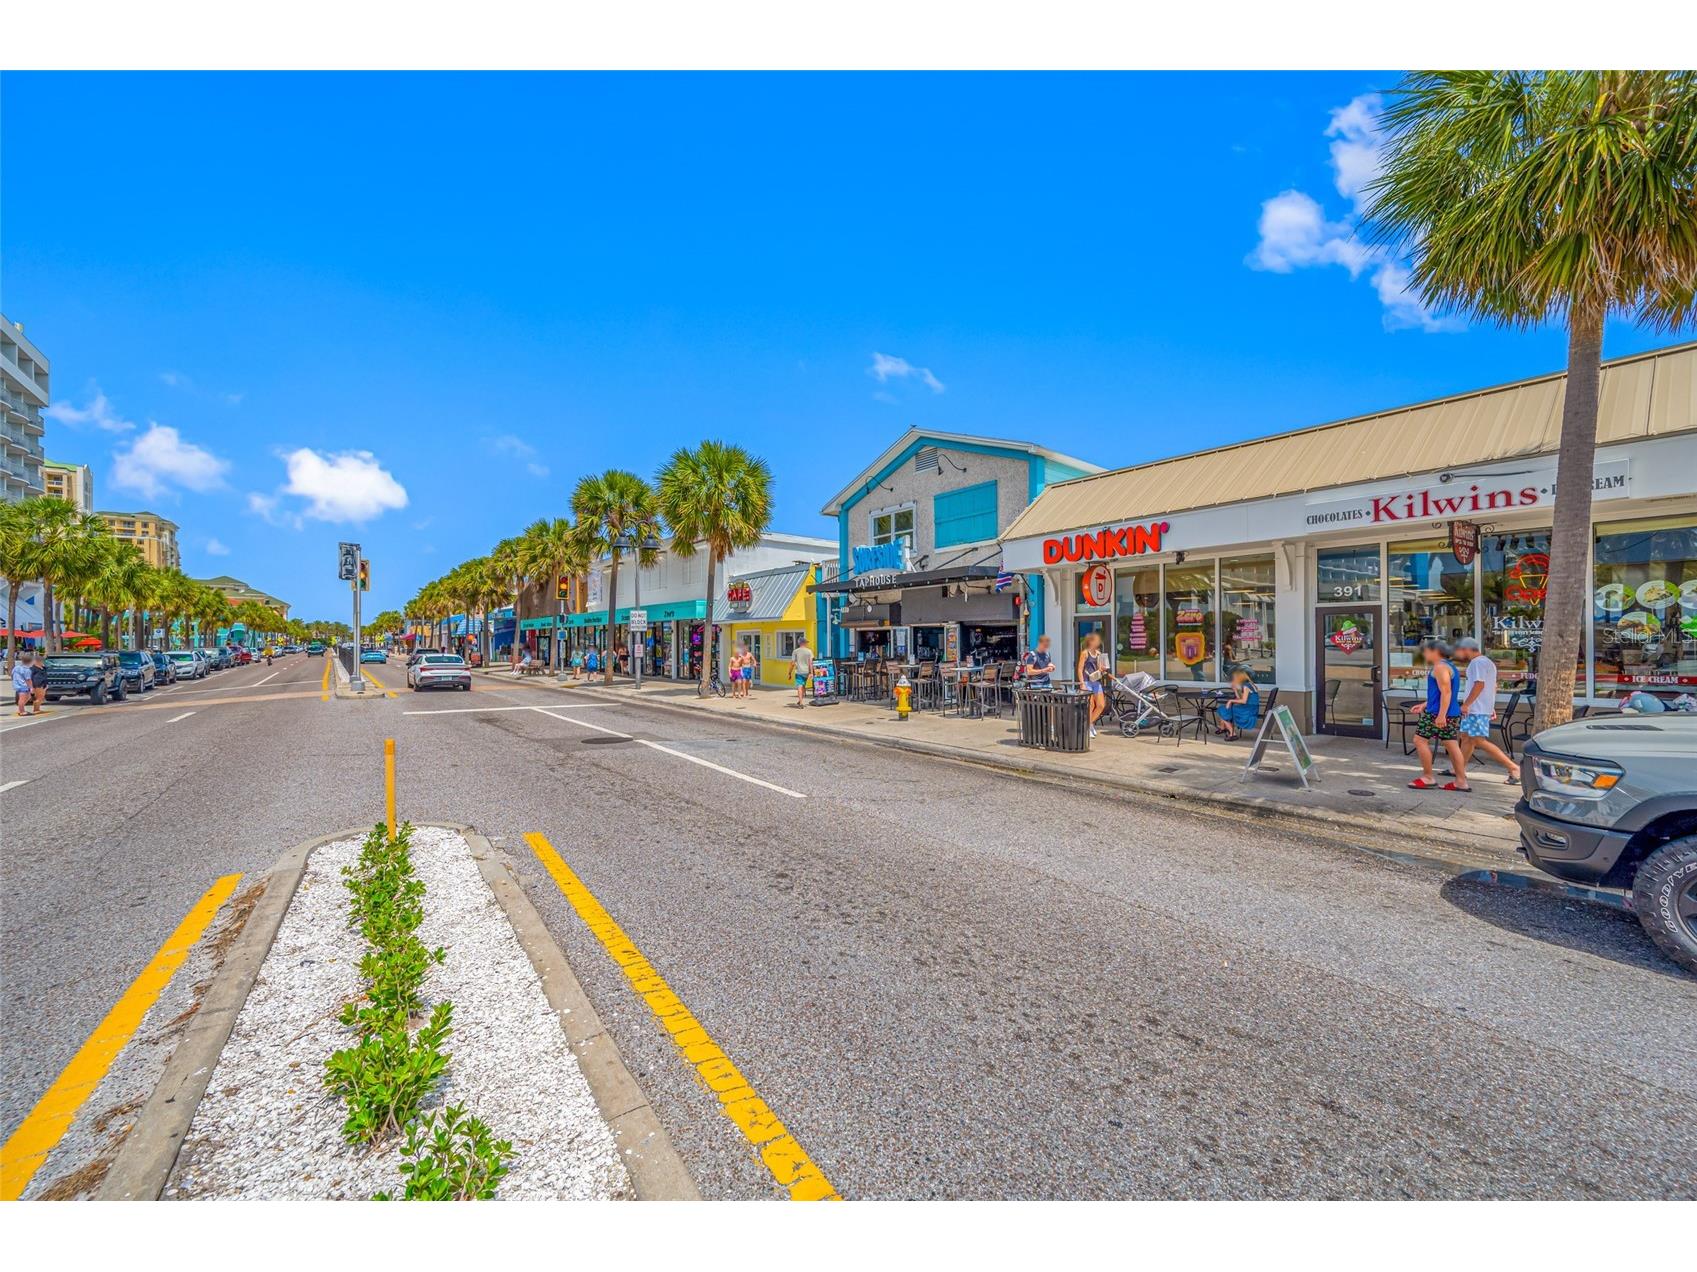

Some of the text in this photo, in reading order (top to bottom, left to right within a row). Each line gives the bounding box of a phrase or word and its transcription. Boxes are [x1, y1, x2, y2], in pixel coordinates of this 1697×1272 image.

[1306, 509, 1363, 525] CHOCOLATES
[1370, 485, 1538, 523] Kilwins
[1043, 521, 1170, 565] DUNKIN'
[855, 574, 897, 588] TAPHOUSE
[1098, 583, 1104, 592] D
[1333, 586, 1362, 597] 391
[1492, 615, 1544, 629] Kilw
[1632, 675, 1679, 684] ICE CREAM
